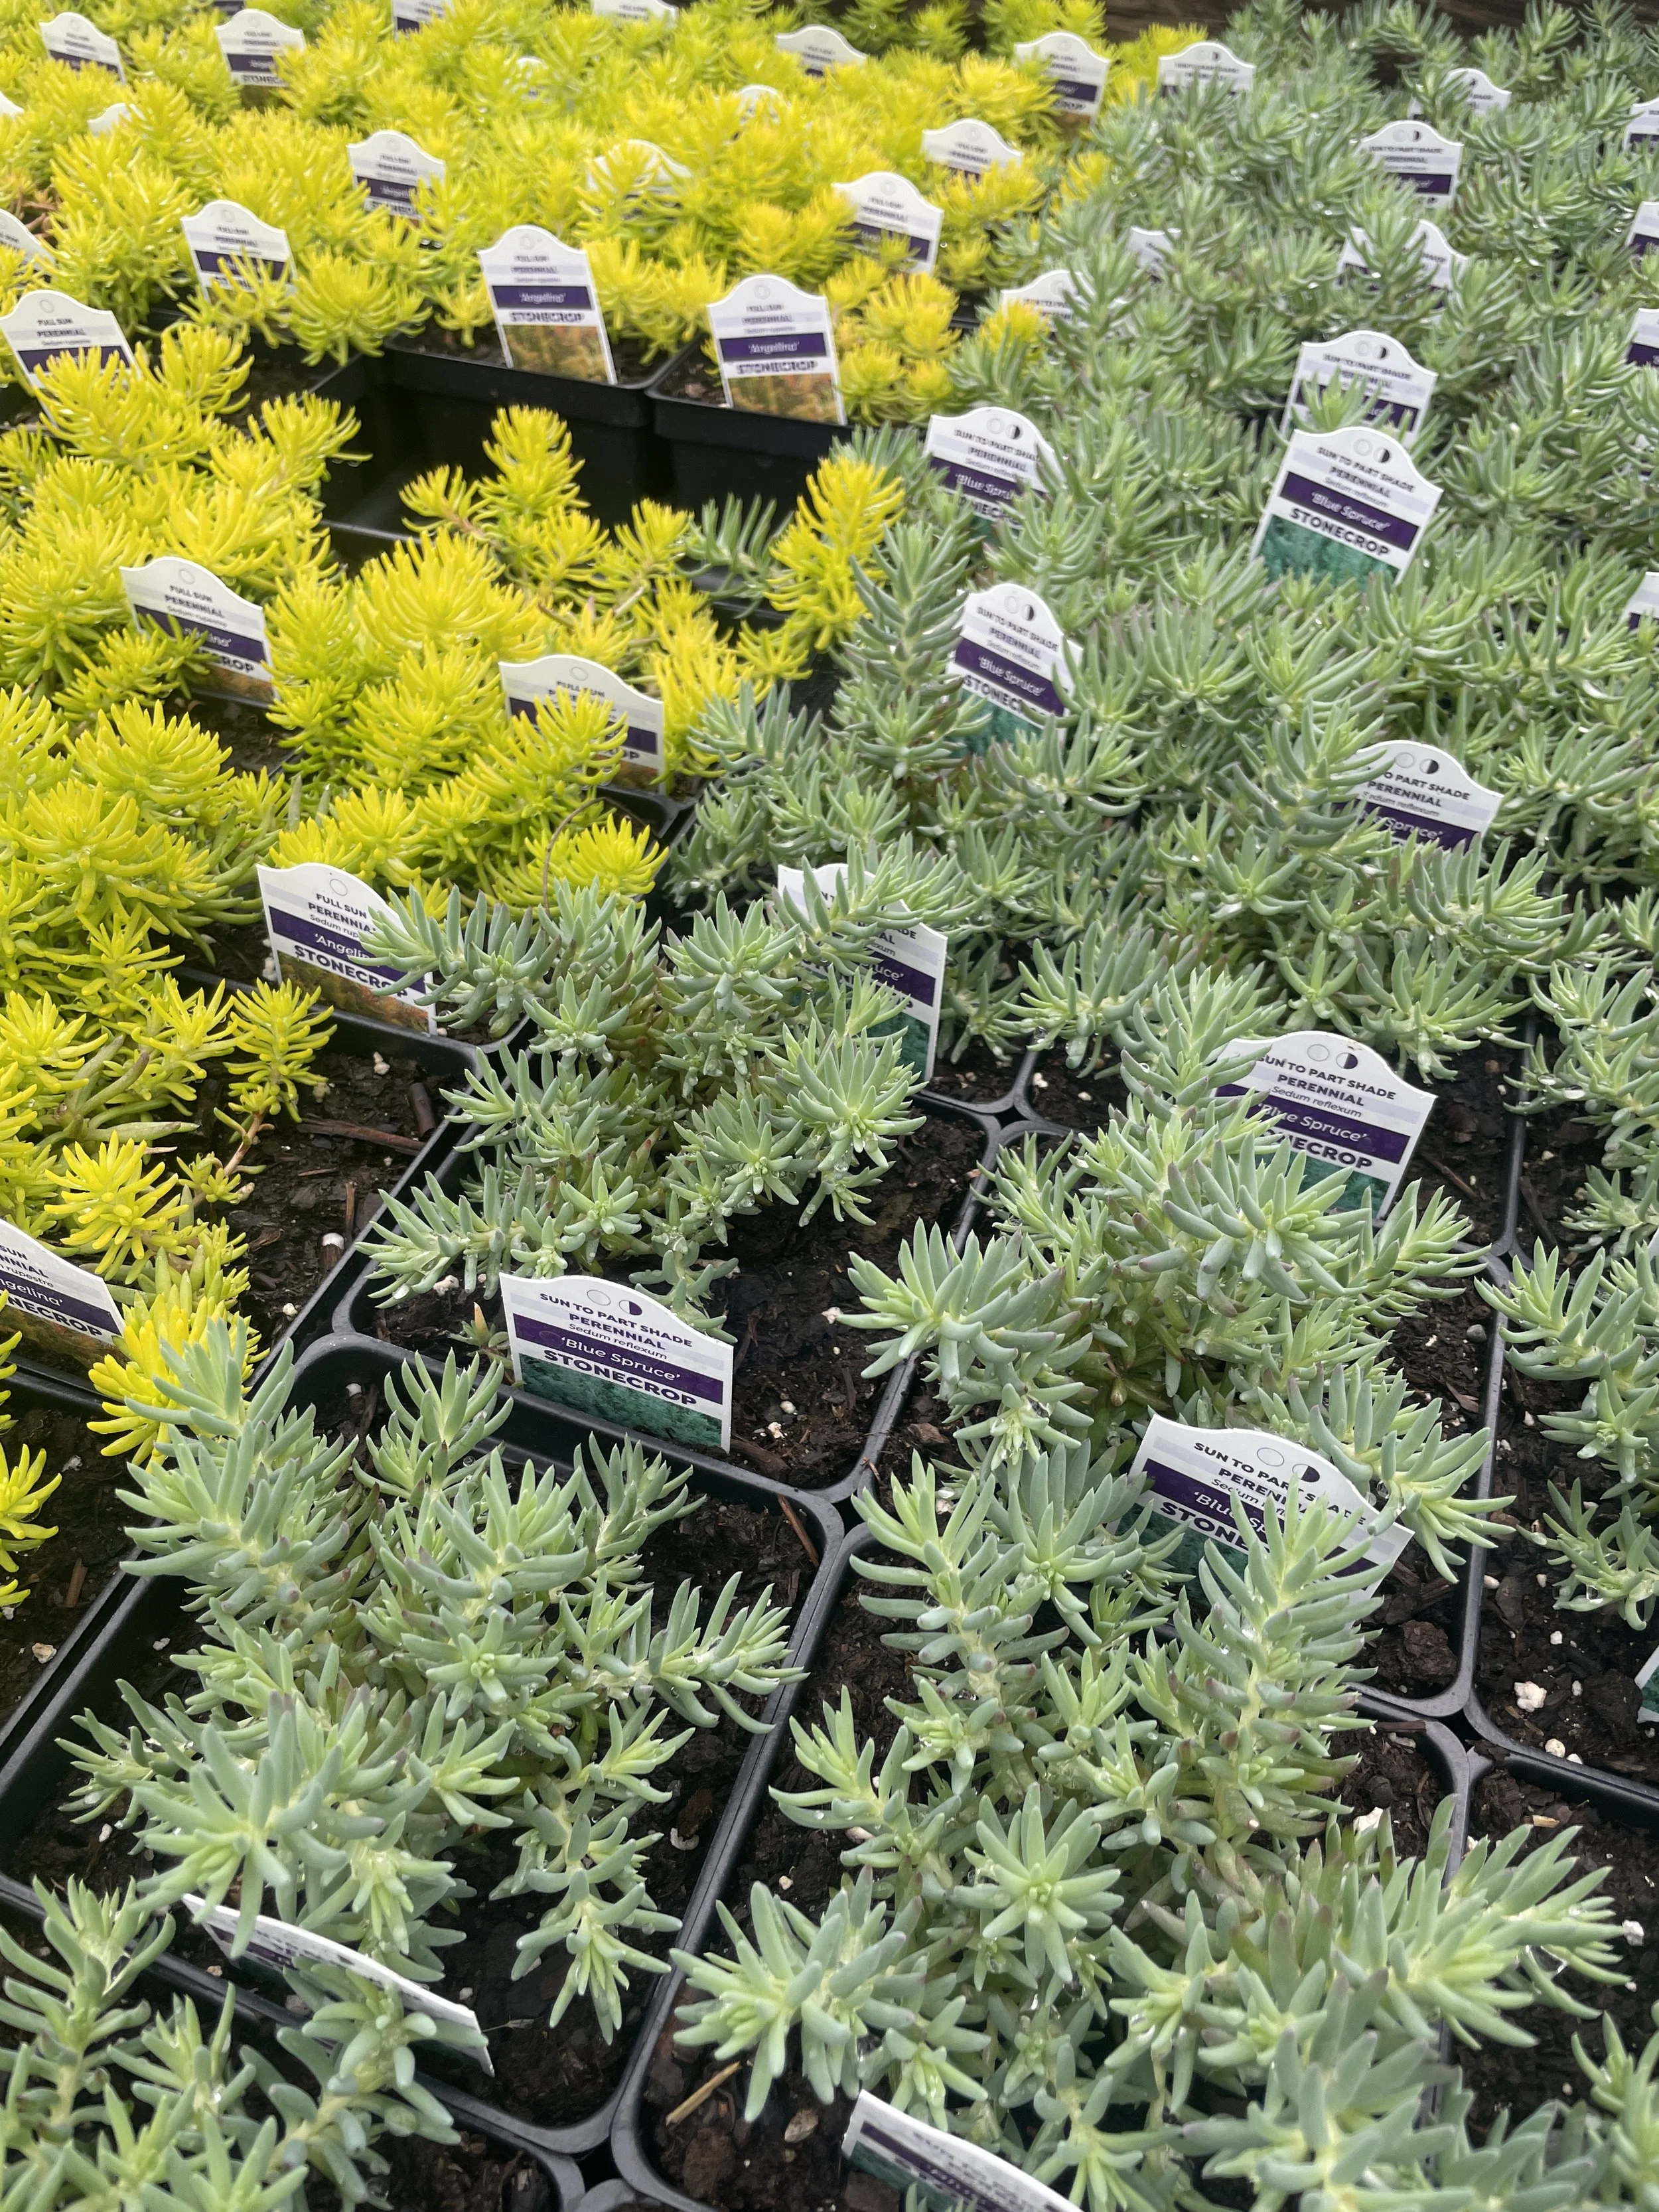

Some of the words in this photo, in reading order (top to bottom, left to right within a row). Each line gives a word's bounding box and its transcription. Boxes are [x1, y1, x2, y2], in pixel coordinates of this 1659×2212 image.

[1317, 446, 1337, 460] SUN
[1340, 455, 1351, 465] TO
[1352, 461, 1379, 478] PART
[1380, 473, 1415, 492] SHADE
[1329, 466, 1392, 498] PERENNIAL
[1311, 491, 1342, 512] 'Blue
[1340, 505, 1391, 532] Spruce'
[1291, 508, 1389, 555] STONECROP
[165, 595, 225, 618] PERENNIAL
[988, 627, 1041, 659] PERENNIAL
[1367, 780, 1442, 807] PERENNIAL
[1395, 774, 1427, 788] PART
[1428, 783, 1471, 800] SHADE
[308, 902, 376, 933] PERENNIA
[316, 893, 342, 910] FULL
[344, 904, 367, 919] SUN
[310, 914, 341, 931] Sedum
[1277, 1074, 1364, 1106] PERENNIAL
[1288, 1062, 1306, 1073] TO
[1309, 1068, 1346, 1085] PART
[1348, 1080, 1396, 1100] SHADE
[1271, 1086, 1310, 1103] Sedum
[1312, 1098, 1362, 1118] reflexum
[1300, 1115, 1367, 1143] Spruce'
[6, 1266, 54, 1288] rupestre
[540, 1293, 570, 1308] SUN
[575, 1302, 594, 1315] TO
[598, 1311, 638, 1329] PART
[640, 1325, 693, 1347] SHADE
[569, 1312, 666, 1350] PERENNIAL
[569, 1323, 611, 1342] Sedum
[614, 1335, 668, 1360] reflexum
[561, 1337, 606, 1358] 'Blue
[610, 1353, 681, 1380] Spruce'
[544, 1349, 697, 1405] STONECROP
[1194, 1442, 1229, 1463] SUN
[1232, 1458, 1254, 1473] TO
